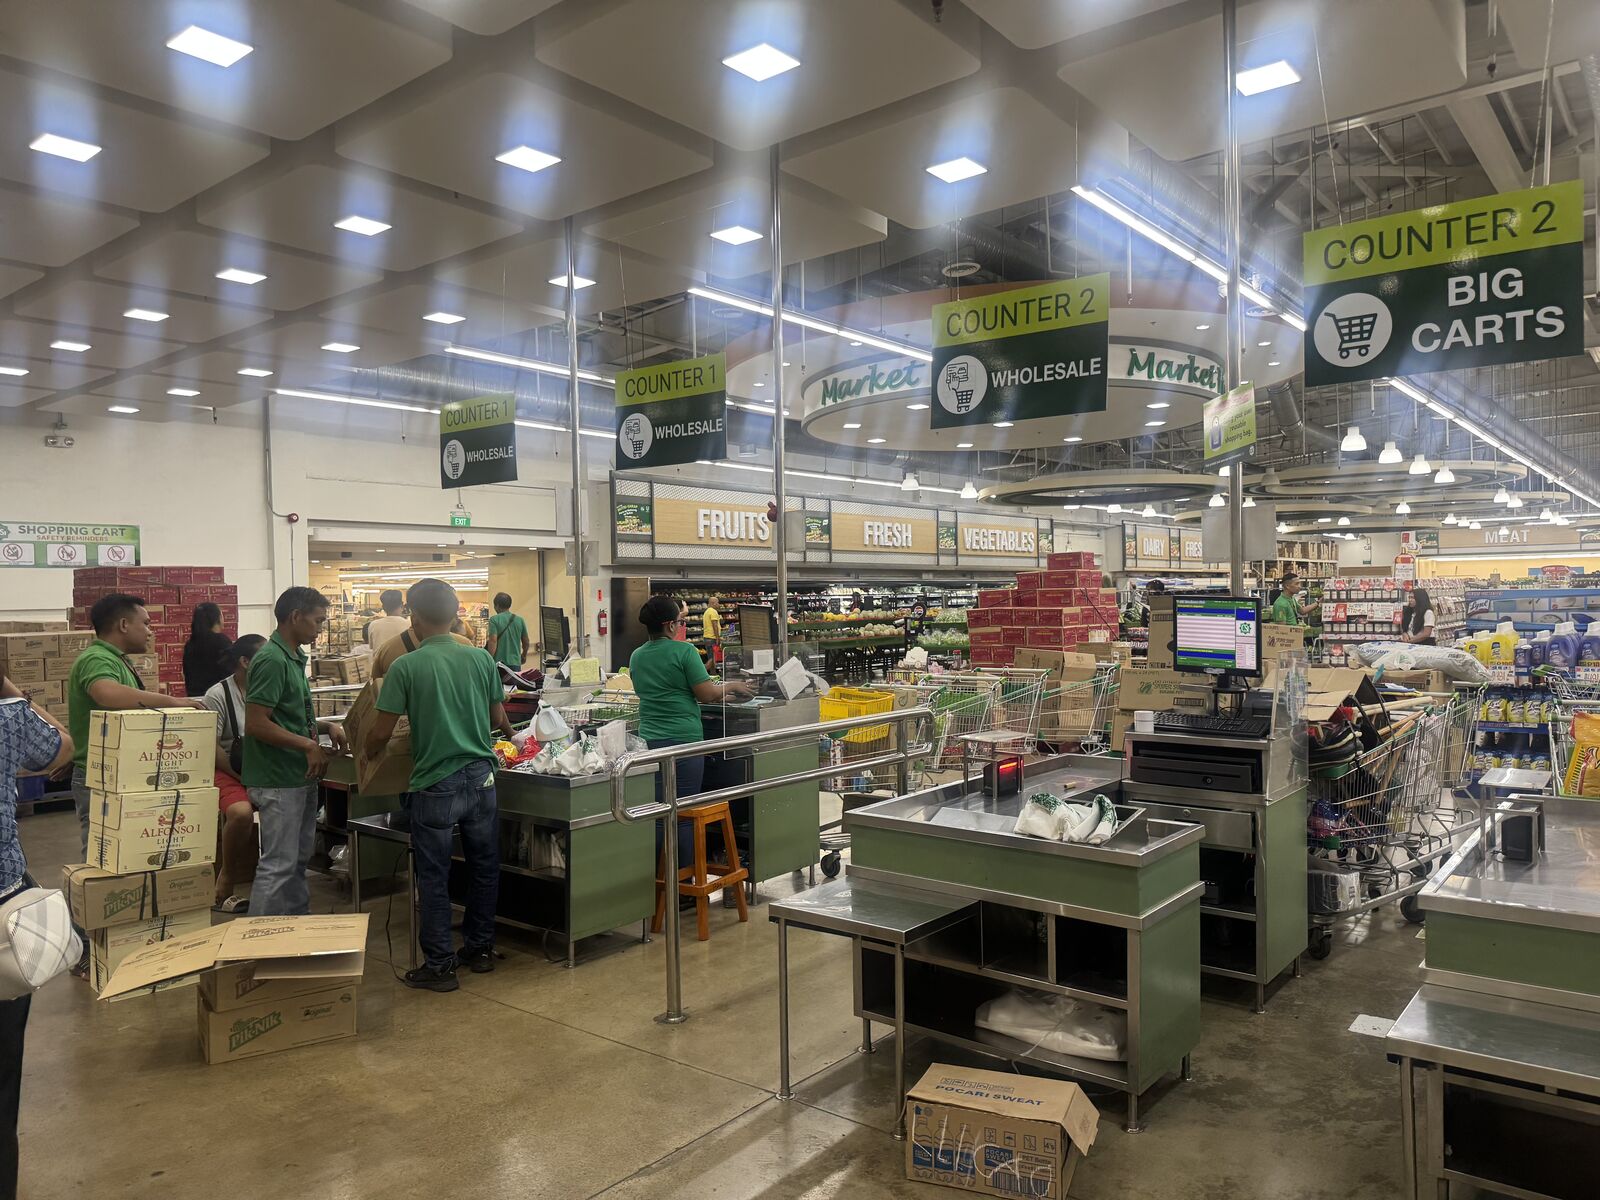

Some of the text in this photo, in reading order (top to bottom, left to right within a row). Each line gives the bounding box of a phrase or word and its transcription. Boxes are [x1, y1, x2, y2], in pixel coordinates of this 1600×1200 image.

[1323, 200, 1557, 270] COUNTER 2
[1447, 267, 1524, 307] BIG
[946, 287, 1096, 337] COUNTER 2
[1411, 305, 1566, 353] CARTS
[625, 364, 716, 398] COUNTER 1
[821, 360, 926, 406] Market
[991, 357, 1102, 388] WHOLESALE
[445, 399, 508, 427] COUNTER 1
[655, 418, 723, 440] WHOLESALE
[466, 445, 514, 463] WHOLESALE
[18, 525, 127, 537] SHOPPING CART
[454, 517, 467, 526] EXIT
[697, 508, 770, 542] FRUITS
[863, 520, 913, 548] FRESH
[962, 527, 1036, 554] VEGETABLES
[1143, 537, 1165, 557] DAIRY
[1484, 529, 1530, 545] MEAT
[935, 1085, 990, 1098] POCARI
[992, 1093, 1045, 1106] SWEAT
[985, 1148, 1012, 1158] POCARI
